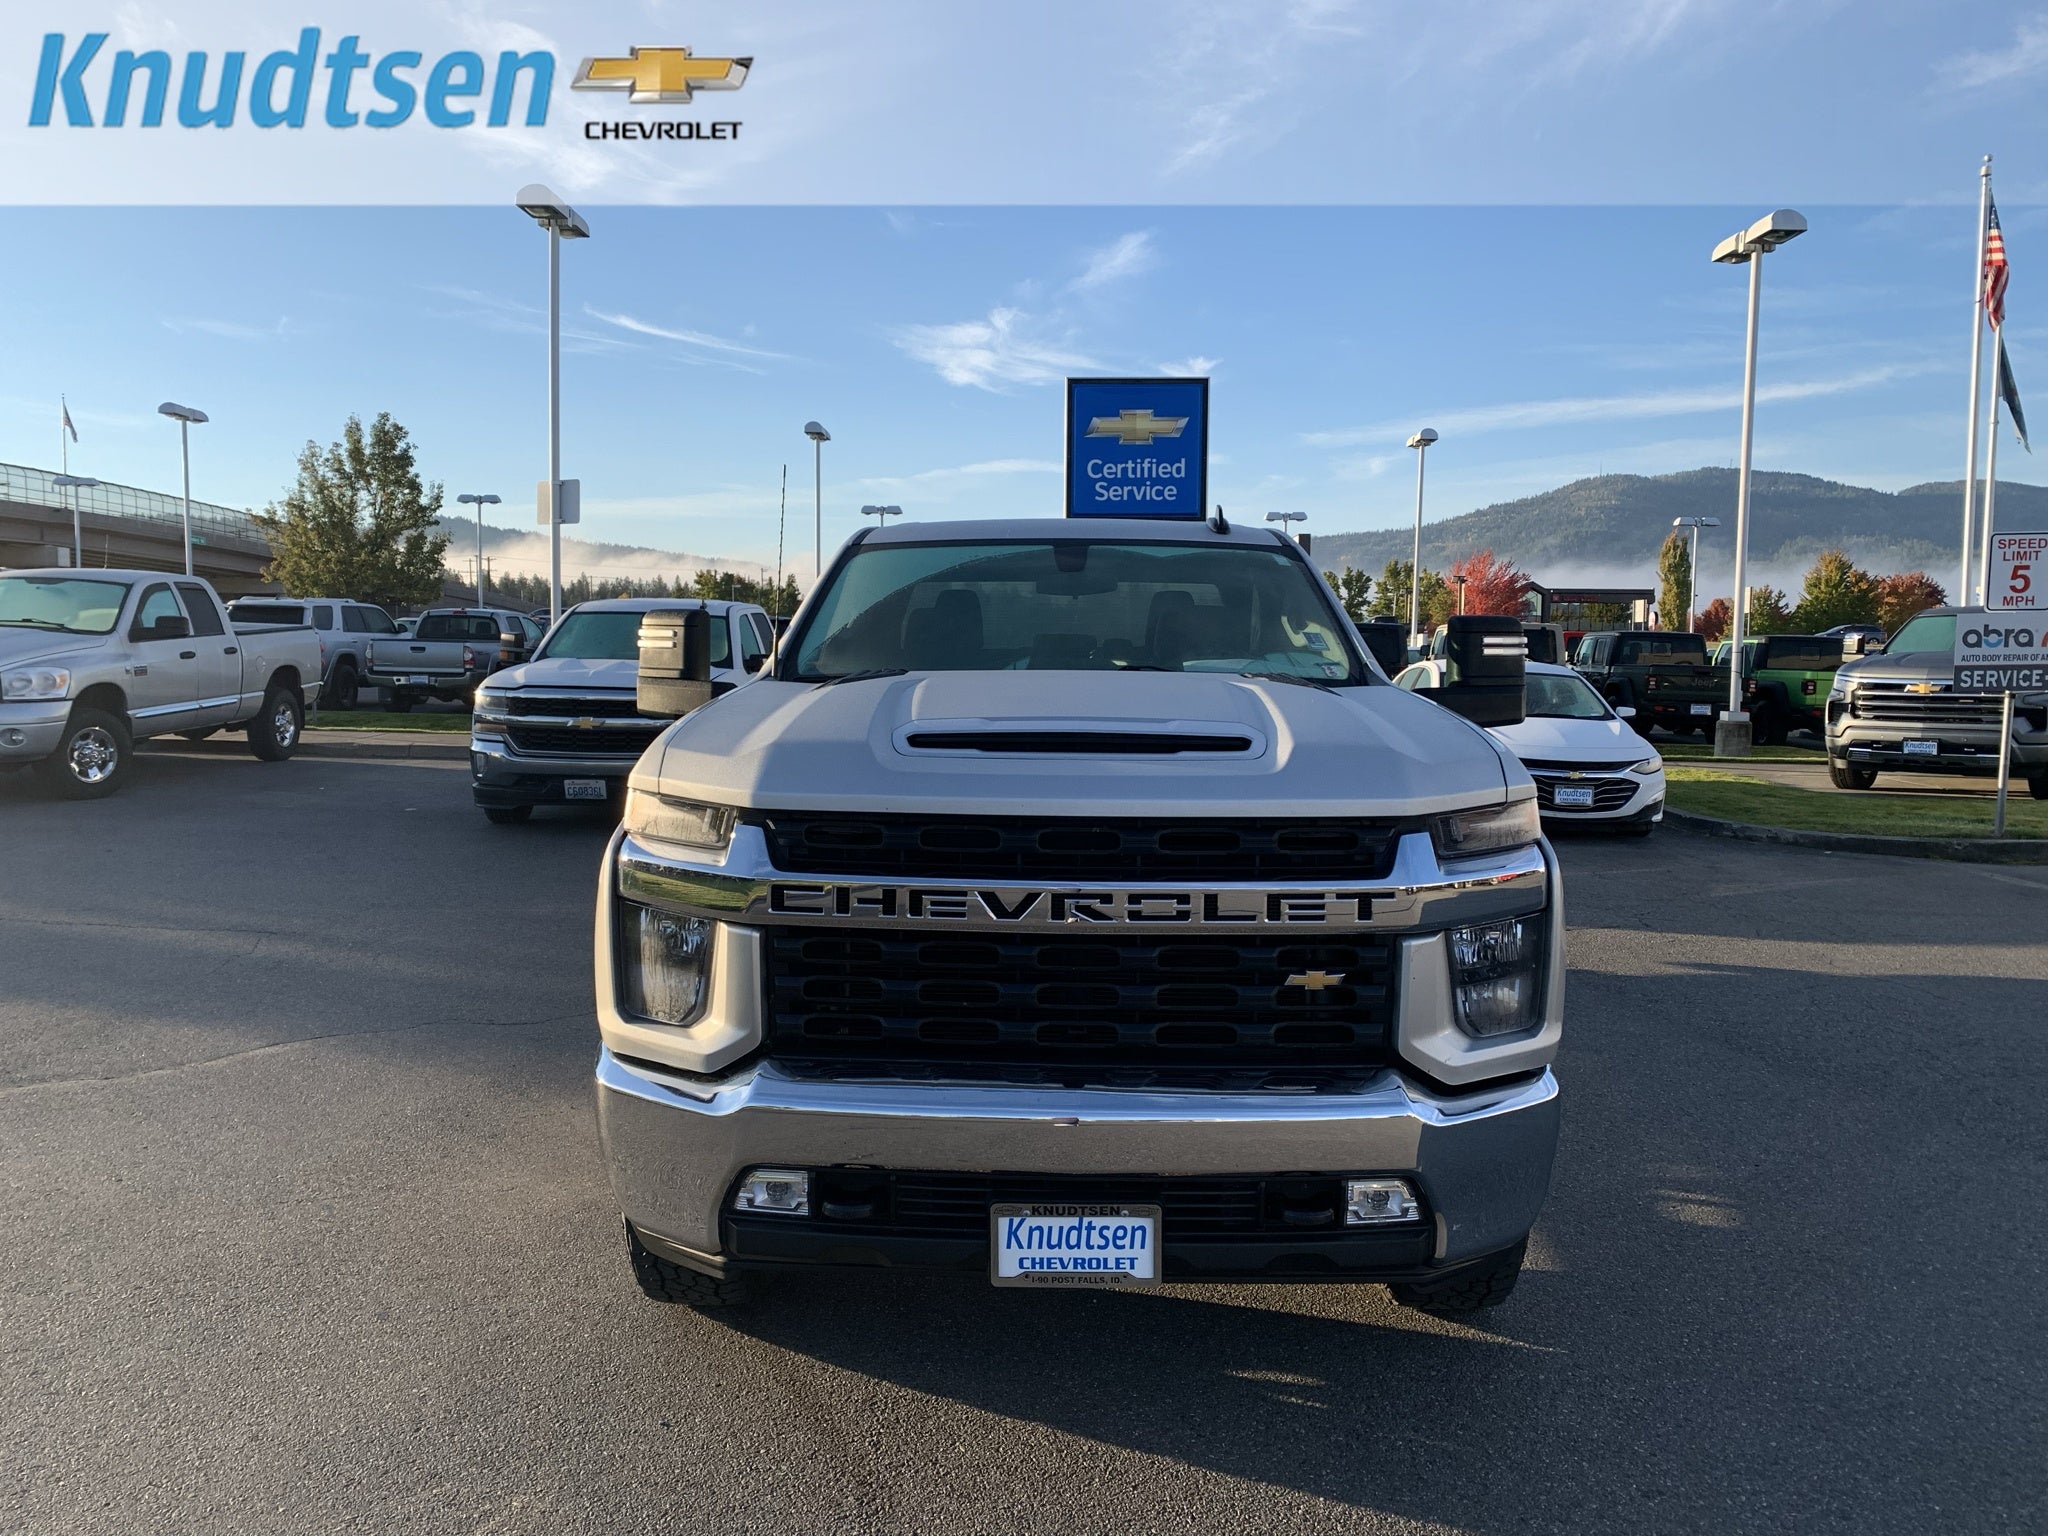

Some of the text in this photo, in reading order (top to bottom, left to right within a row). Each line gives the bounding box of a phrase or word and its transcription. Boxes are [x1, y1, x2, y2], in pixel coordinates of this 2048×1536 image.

[1087, 458, 1185, 478] Certified
[1095, 481, 1177, 500] Service
[1998, 538, 2047, 549] SPEED
[2003, 551, 2041, 561] LIMIT
[2009, 565, 2031, 593] 5
[2002, 596, 2035, 606] MPH
[1962, 624, 2034, 648] abra
[1961, 654, 1980, 662] AUTO
[2003, 653, 2029, 661] REPAIR
[2030, 653, 2040, 661] OF
[1557, 788, 1591, 798] Knudtsen
[767, 883, 1396, 923] CHEVROLET
[1031, 1205, 1121, 1216] KNUDTSEN
[1006, 1217, 1147, 1250] Knudtsen
[1018, 1257, 1139, 1270] CHEVROLET
[1051, 1276, 1075, 1284] POST
[1077, 1276, 1108, 1285] FALLS,
[1110, 1276, 1123, 1284] ID.
